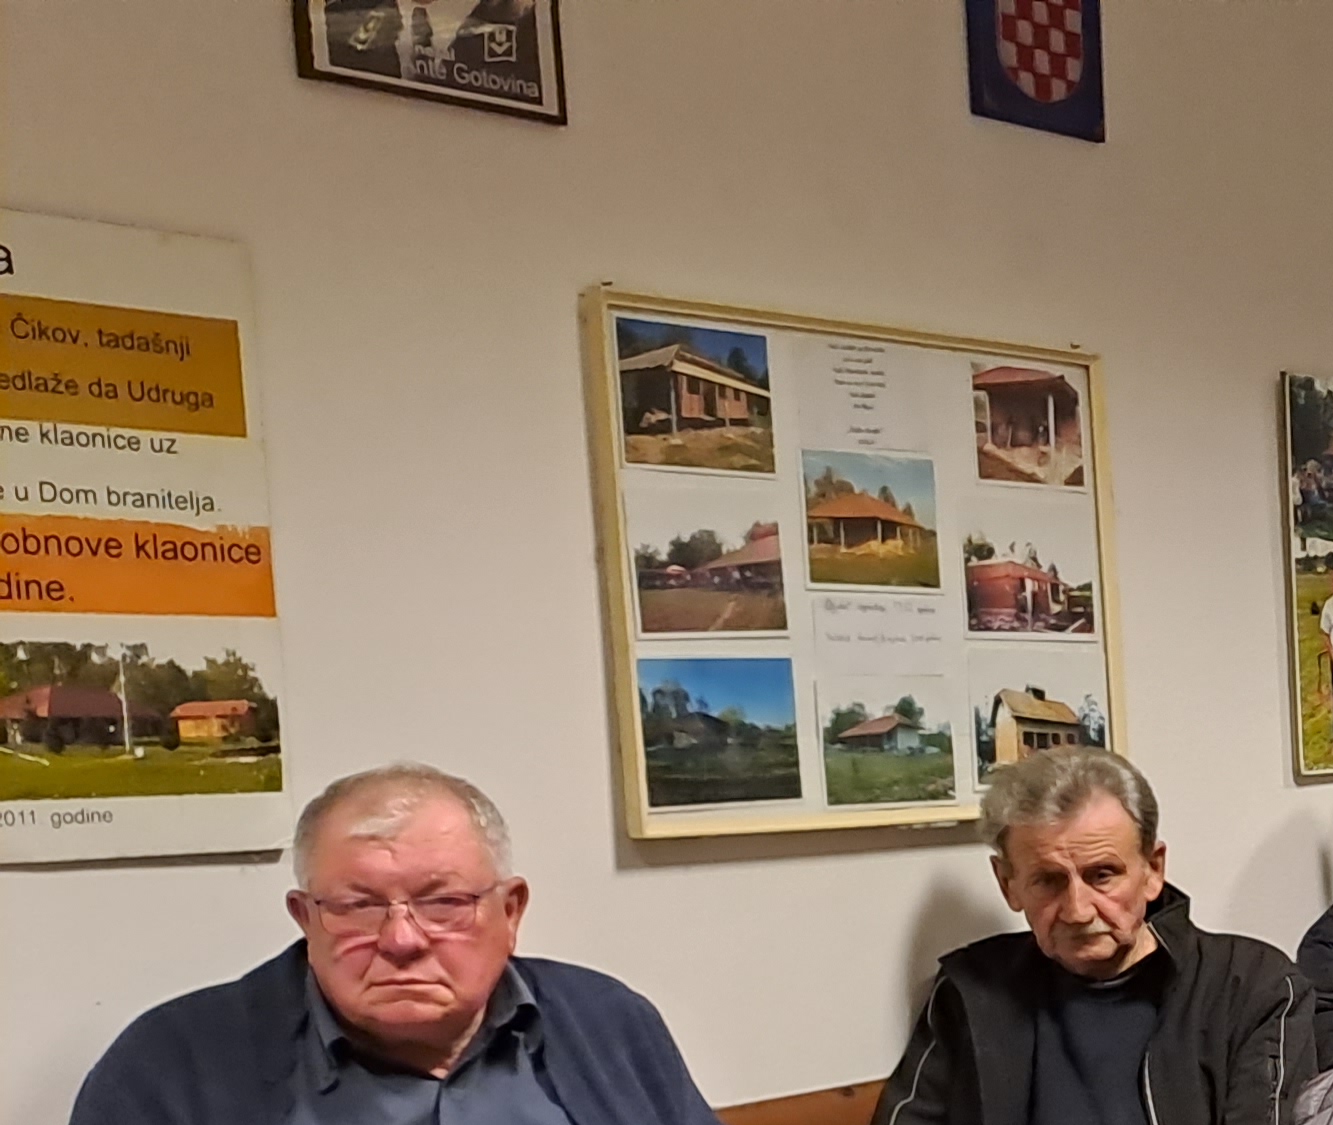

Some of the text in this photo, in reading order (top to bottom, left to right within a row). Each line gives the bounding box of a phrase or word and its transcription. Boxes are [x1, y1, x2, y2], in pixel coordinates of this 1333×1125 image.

[96, 327, 192, 361] tadašnji
[88, 377, 120, 400] da
[126, 379, 214, 412] Udruga
[39, 422, 142, 452] klaonice
[150, 438, 179, 455] uz
[14, 486, 30, 502] u
[39, 481, 97, 505] Dom
[106, 486, 222, 517] branitelja.
[1, 526, 262, 565] obnove klaonice
[0, 807, 114, 830] 011 godine
